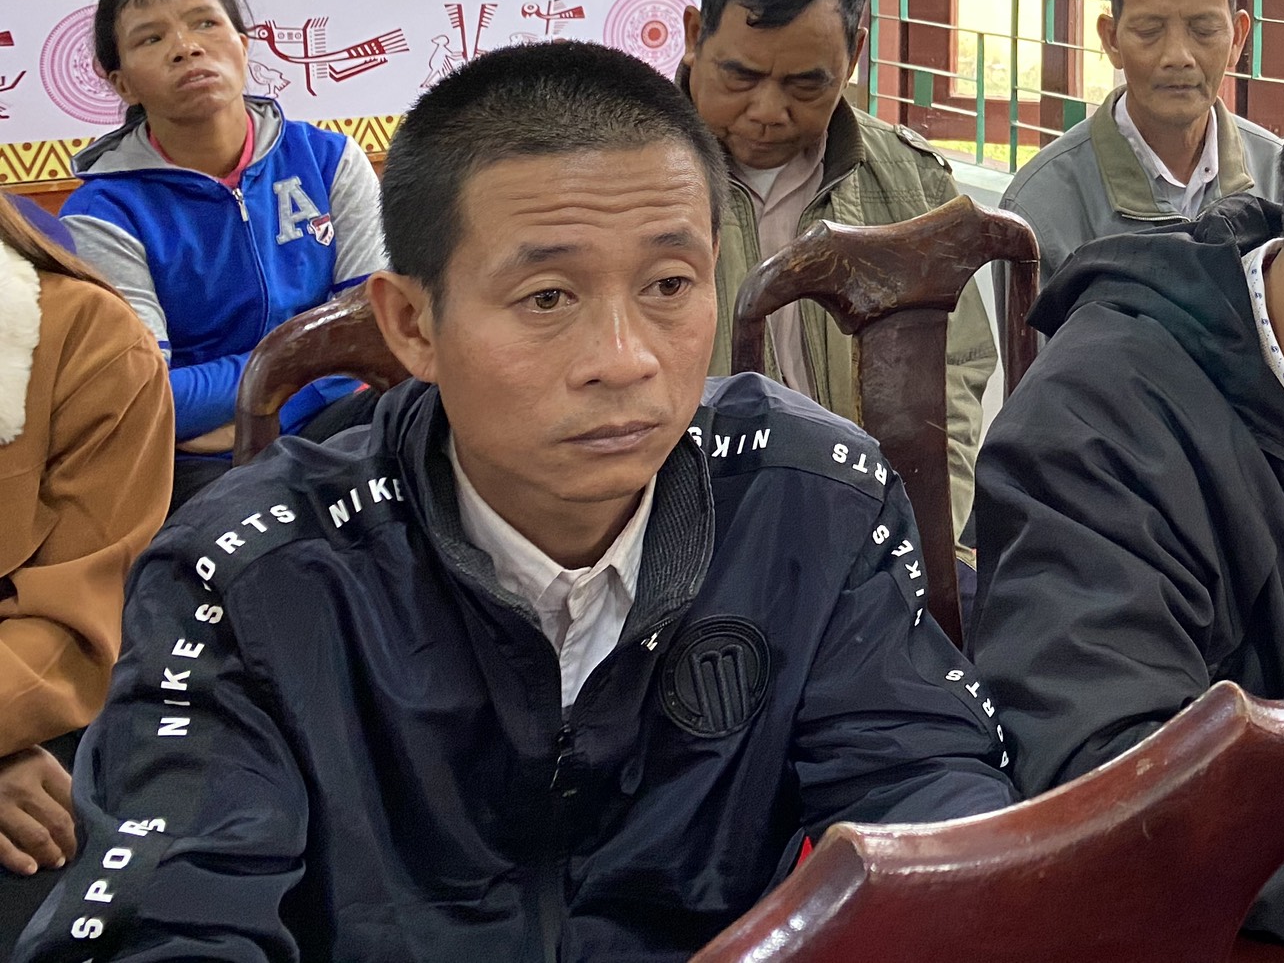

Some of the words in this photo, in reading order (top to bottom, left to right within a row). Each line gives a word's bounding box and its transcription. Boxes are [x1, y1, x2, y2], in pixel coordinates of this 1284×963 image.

[273, 176, 321, 245] A
[158, 638, 206, 738] NIKE
[195, 504, 297, 625] SORTS
